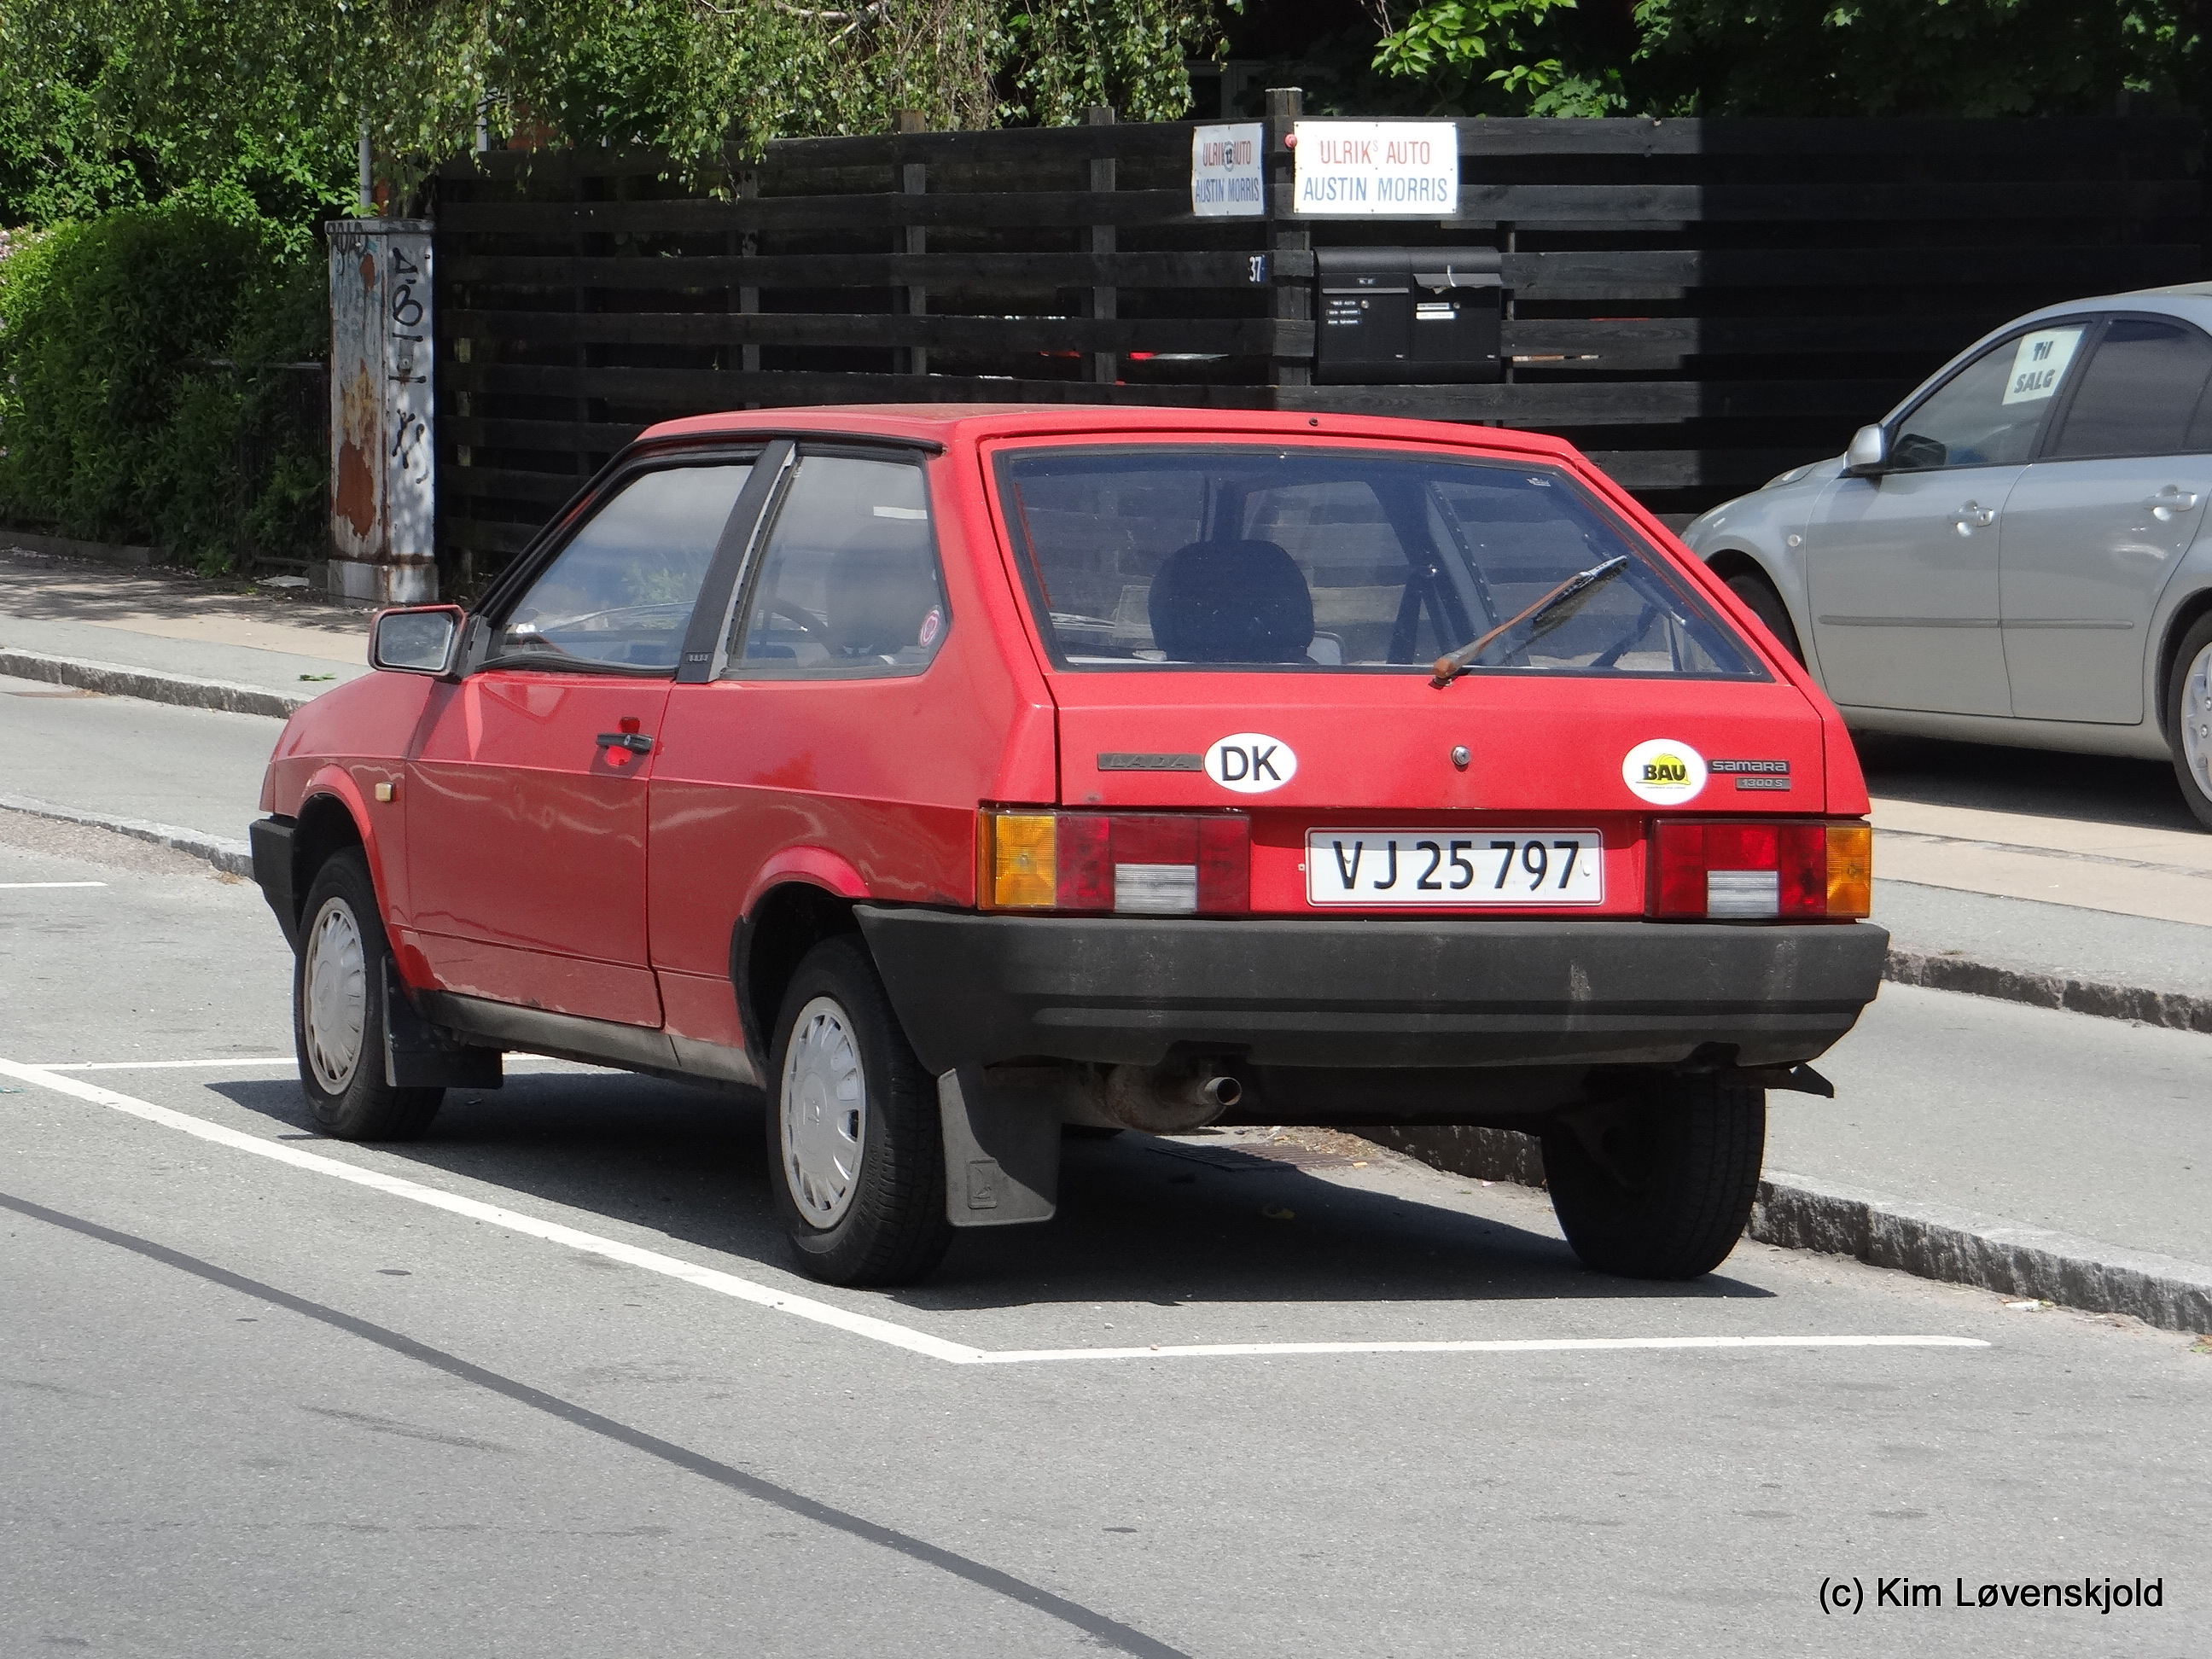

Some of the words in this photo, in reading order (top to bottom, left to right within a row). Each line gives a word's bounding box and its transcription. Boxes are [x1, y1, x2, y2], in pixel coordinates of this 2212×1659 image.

[1386, 141, 1430, 165] AUTO
[1195, 178, 1225, 203] AUSTIN
[1227, 177, 1260, 203] MORRIS
[1303, 177, 1367, 201] AUSTIN
[1377, 178, 1447, 202] MORRIS
[1249, 255, 1262, 282] 37
[2032, 341, 2054, 362] Til
[2013, 369, 2056, 394] SALG
[1220, 745, 1282, 782] DK
[1642, 764, 1686, 781] BAU
[1331, 840, 1397, 890] VJ
[1415, 840, 1475, 890] 25
[1489, 840, 1580, 892] 797
